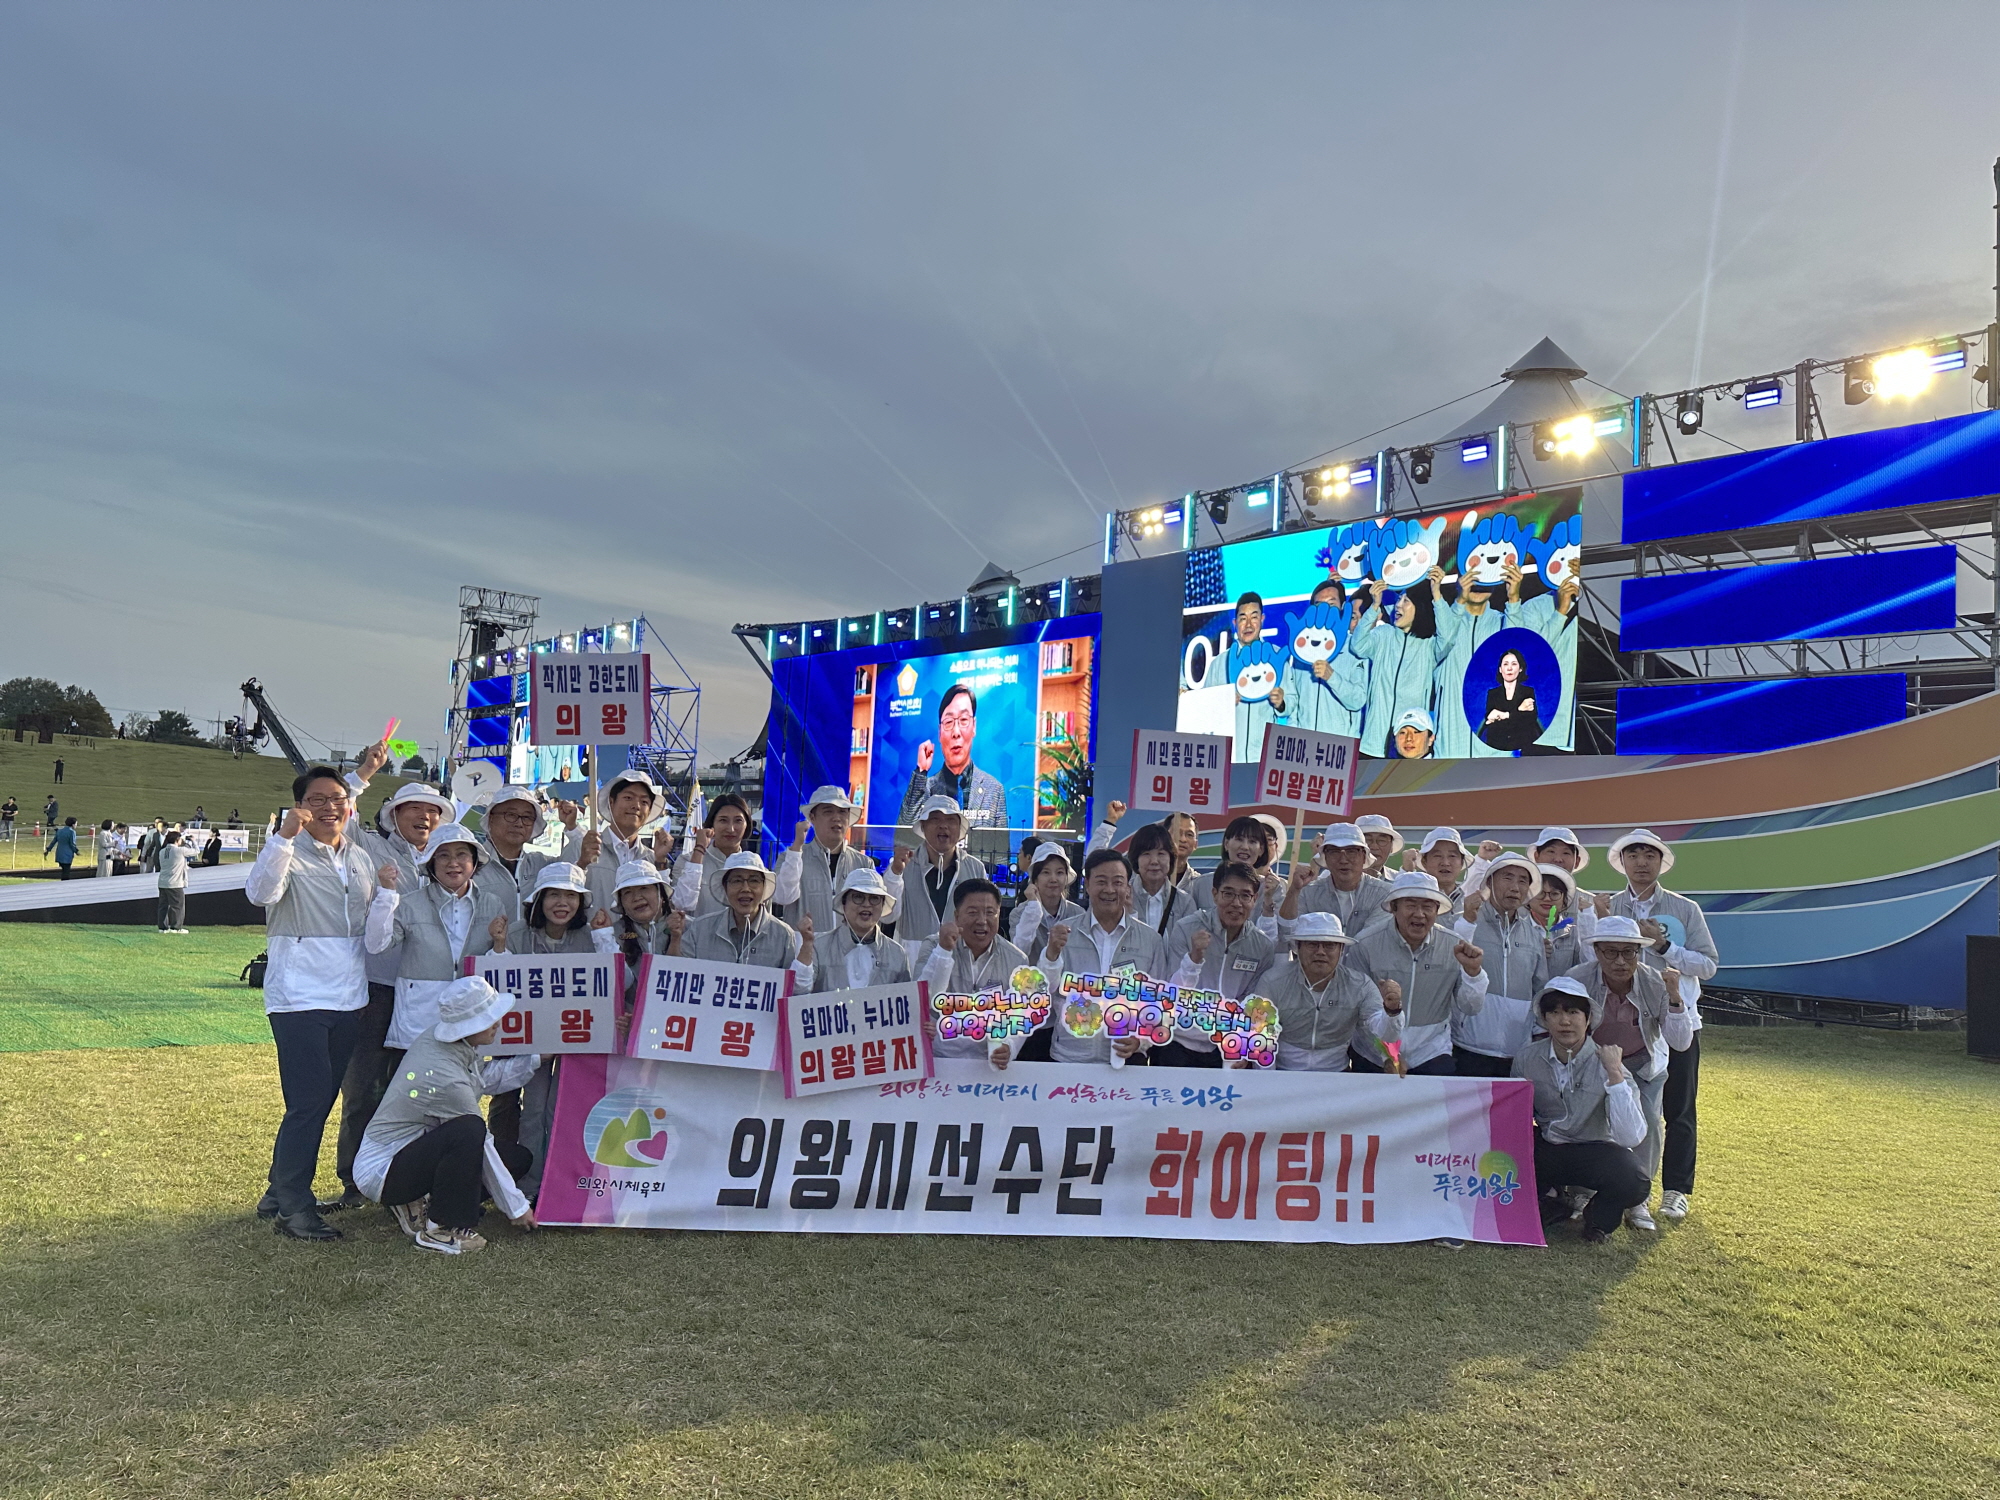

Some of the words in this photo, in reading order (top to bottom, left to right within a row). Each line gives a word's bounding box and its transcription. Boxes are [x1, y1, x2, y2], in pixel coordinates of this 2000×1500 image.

[542, 664, 581, 693] 작지만
[588, 664, 639, 693] 강한도시
[1146, 740, 1218, 770] 시민중심도시
[1275, 735, 1309, 767] 엄마야,
[1315, 742, 1347, 770] 누나야
[1266, 768, 1344, 807] 의왕살자
[484, 967, 608, 1000] 시민중심도시
[655, 970, 704, 1005] 작지만
[712, 975, 777, 1012] 강한도시
[1064, 973, 1176, 1003] 시민중심도시
[801, 1003, 856, 1039] 엄마야,
[863, 995, 910, 1030] 누나야
[940, 1014, 1033, 1041] 의왕살자
[1104, 1004, 1176, 1044] 의왕
[1176, 1004, 1252, 1032] 강한도시
[800, 1035, 918, 1085] 의왕살자
[1221, 1032, 1278, 1066] 의왕
[957, 1083, 1038, 1102] 미래도시
[1047, 1083, 1136, 1103] 생동하는
[1139, 1085, 1177, 1107] 푸른
[1180, 1084, 1242, 1112] 의왕
[716, 1117, 1116, 1216] 의왕시선수단
[1144, 1126, 1380, 1224] 화이팅!!
[1415, 1152, 1477, 1172] 미래도시
[576, 1176, 666, 1198] 의왕시체육회
